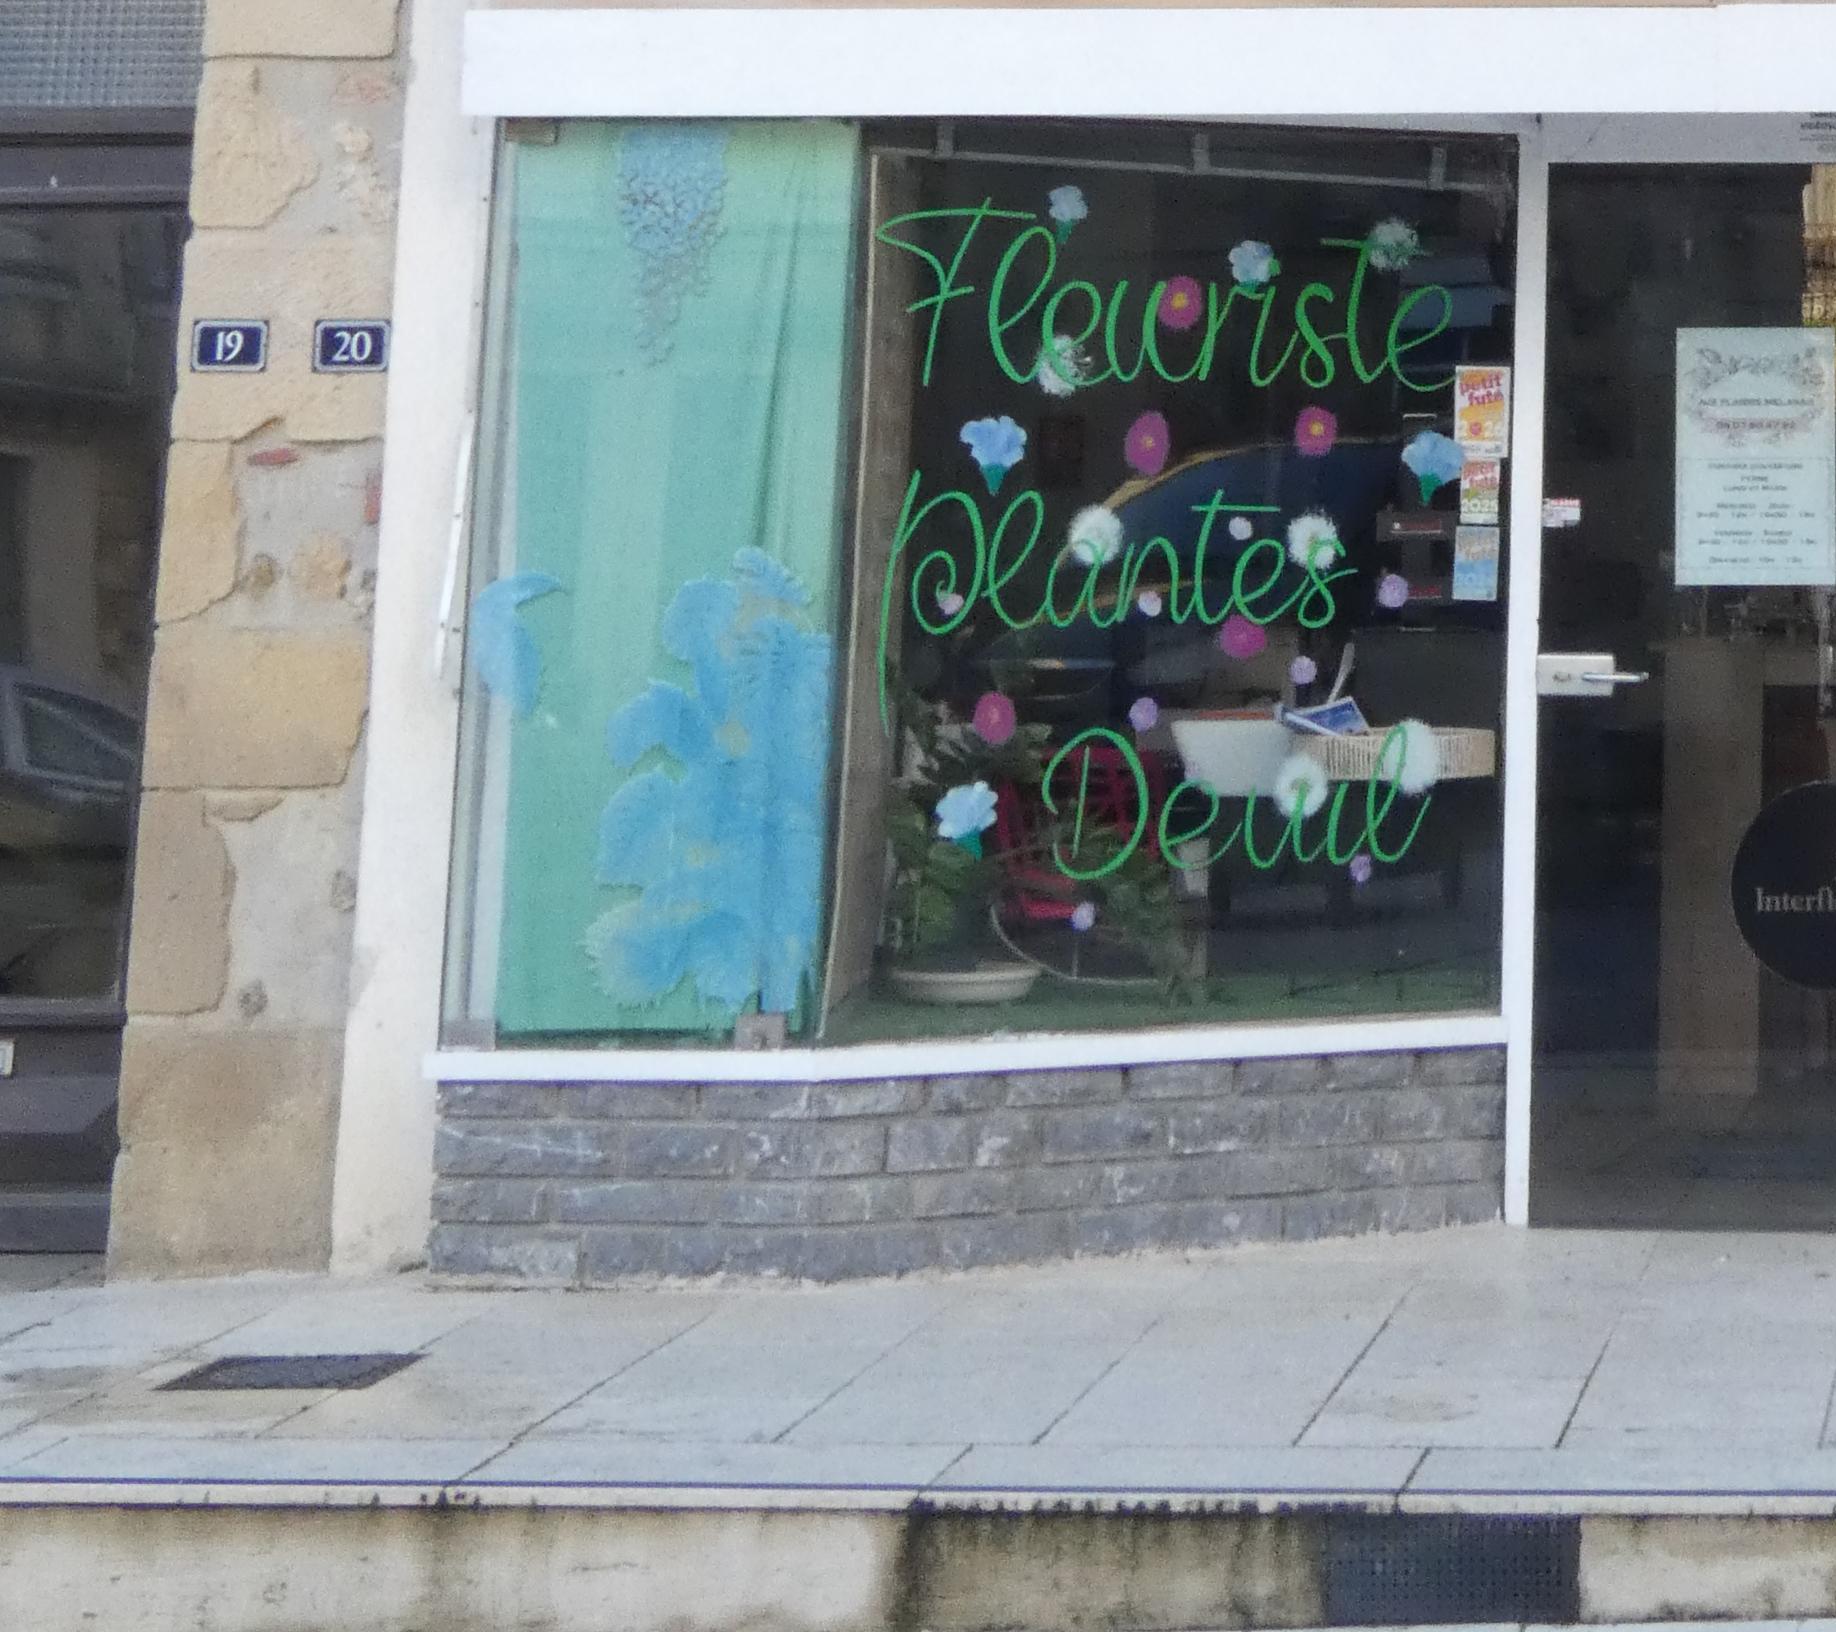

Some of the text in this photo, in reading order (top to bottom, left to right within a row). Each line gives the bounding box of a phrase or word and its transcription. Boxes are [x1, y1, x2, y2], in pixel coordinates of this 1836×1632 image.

[213, 330, 244, 362] 19
[331, 330, 372, 362] 20
[876, 197, 1457, 391] Fleuriste
[877, 470, 1359, 736] Plantes
[1041, 724, 1432, 880] Deuil
